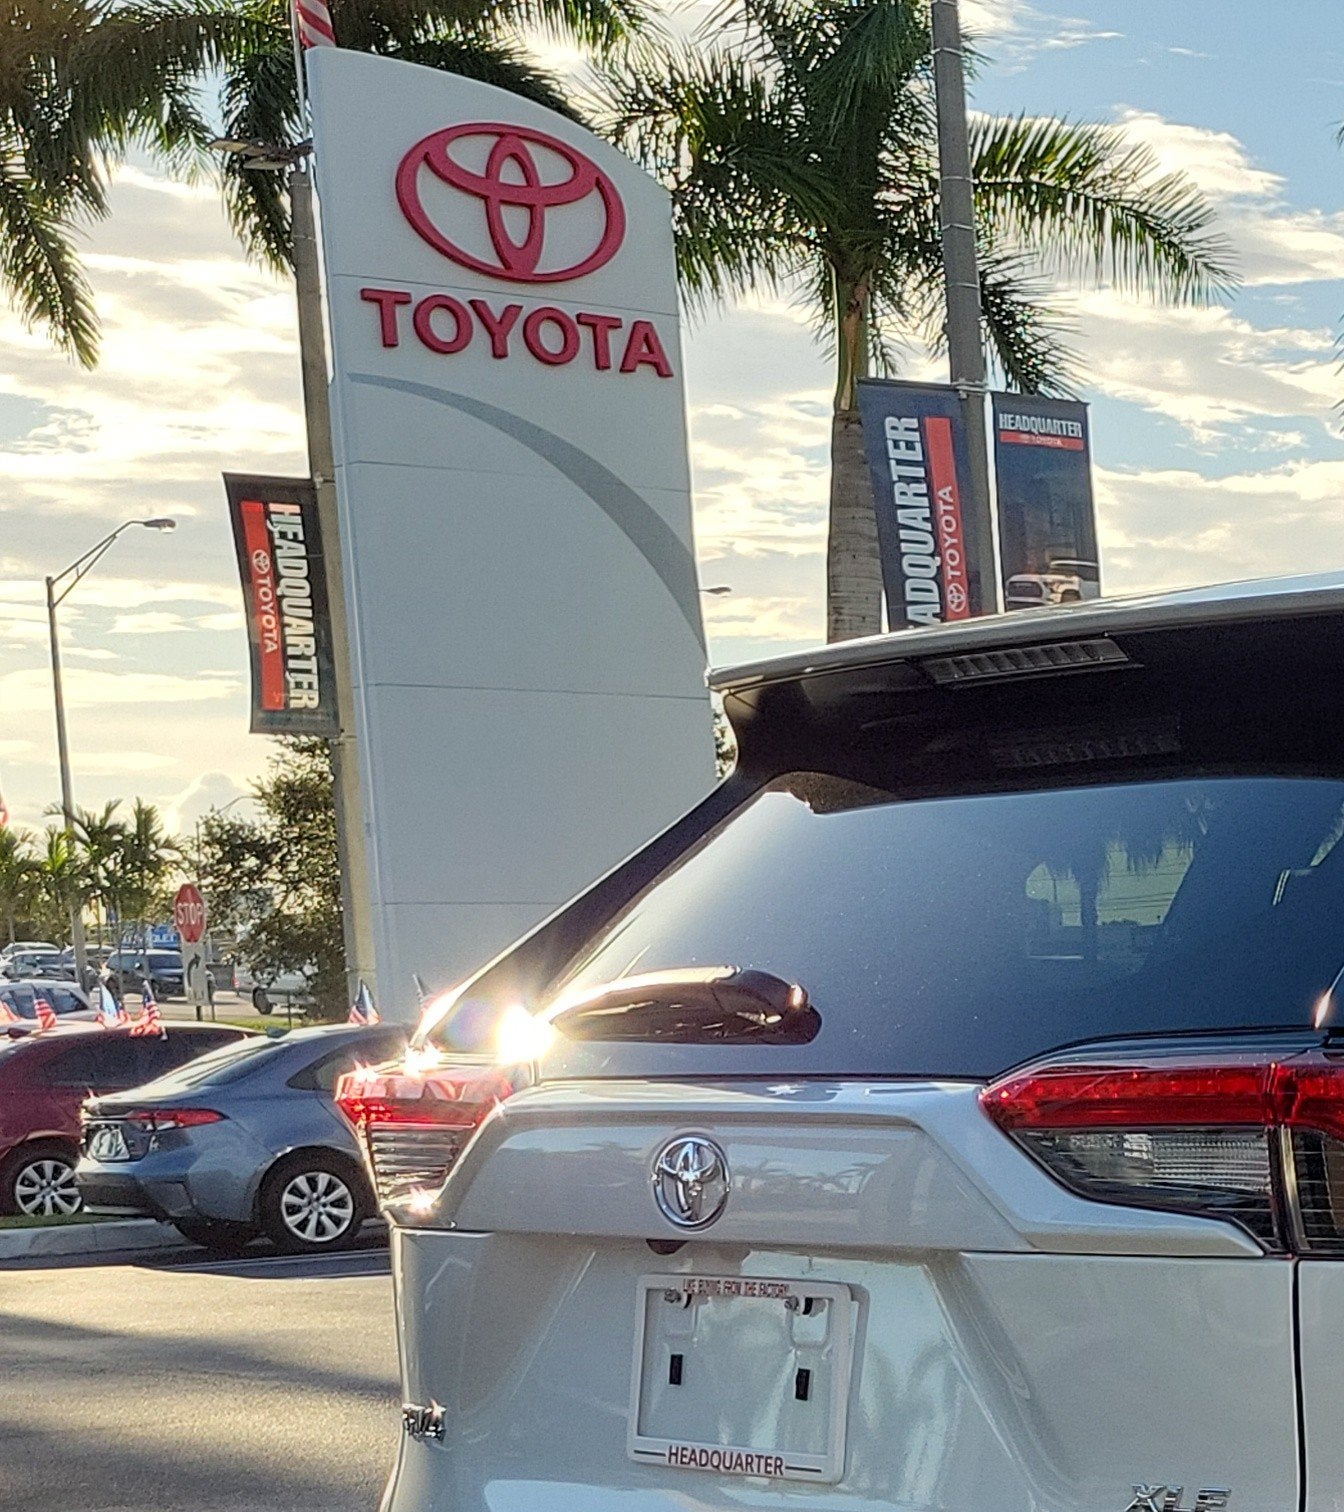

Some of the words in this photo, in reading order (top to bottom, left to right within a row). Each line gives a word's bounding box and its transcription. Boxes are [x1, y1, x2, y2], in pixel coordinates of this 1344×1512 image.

[360, 287, 673, 378] TOYOTA
[998, 413, 1083, 438] HEADQUARTER
[884, 416, 942, 626] ADQUARTER
[937, 486, 961, 580] TOYOTA
[257, 576, 280, 654] TOYOTA
[267, 502, 320, 710] HEADQUARTER
[176, 902, 203, 925] STOP
[667, 1445, 785, 1476] HEADQUARTER
